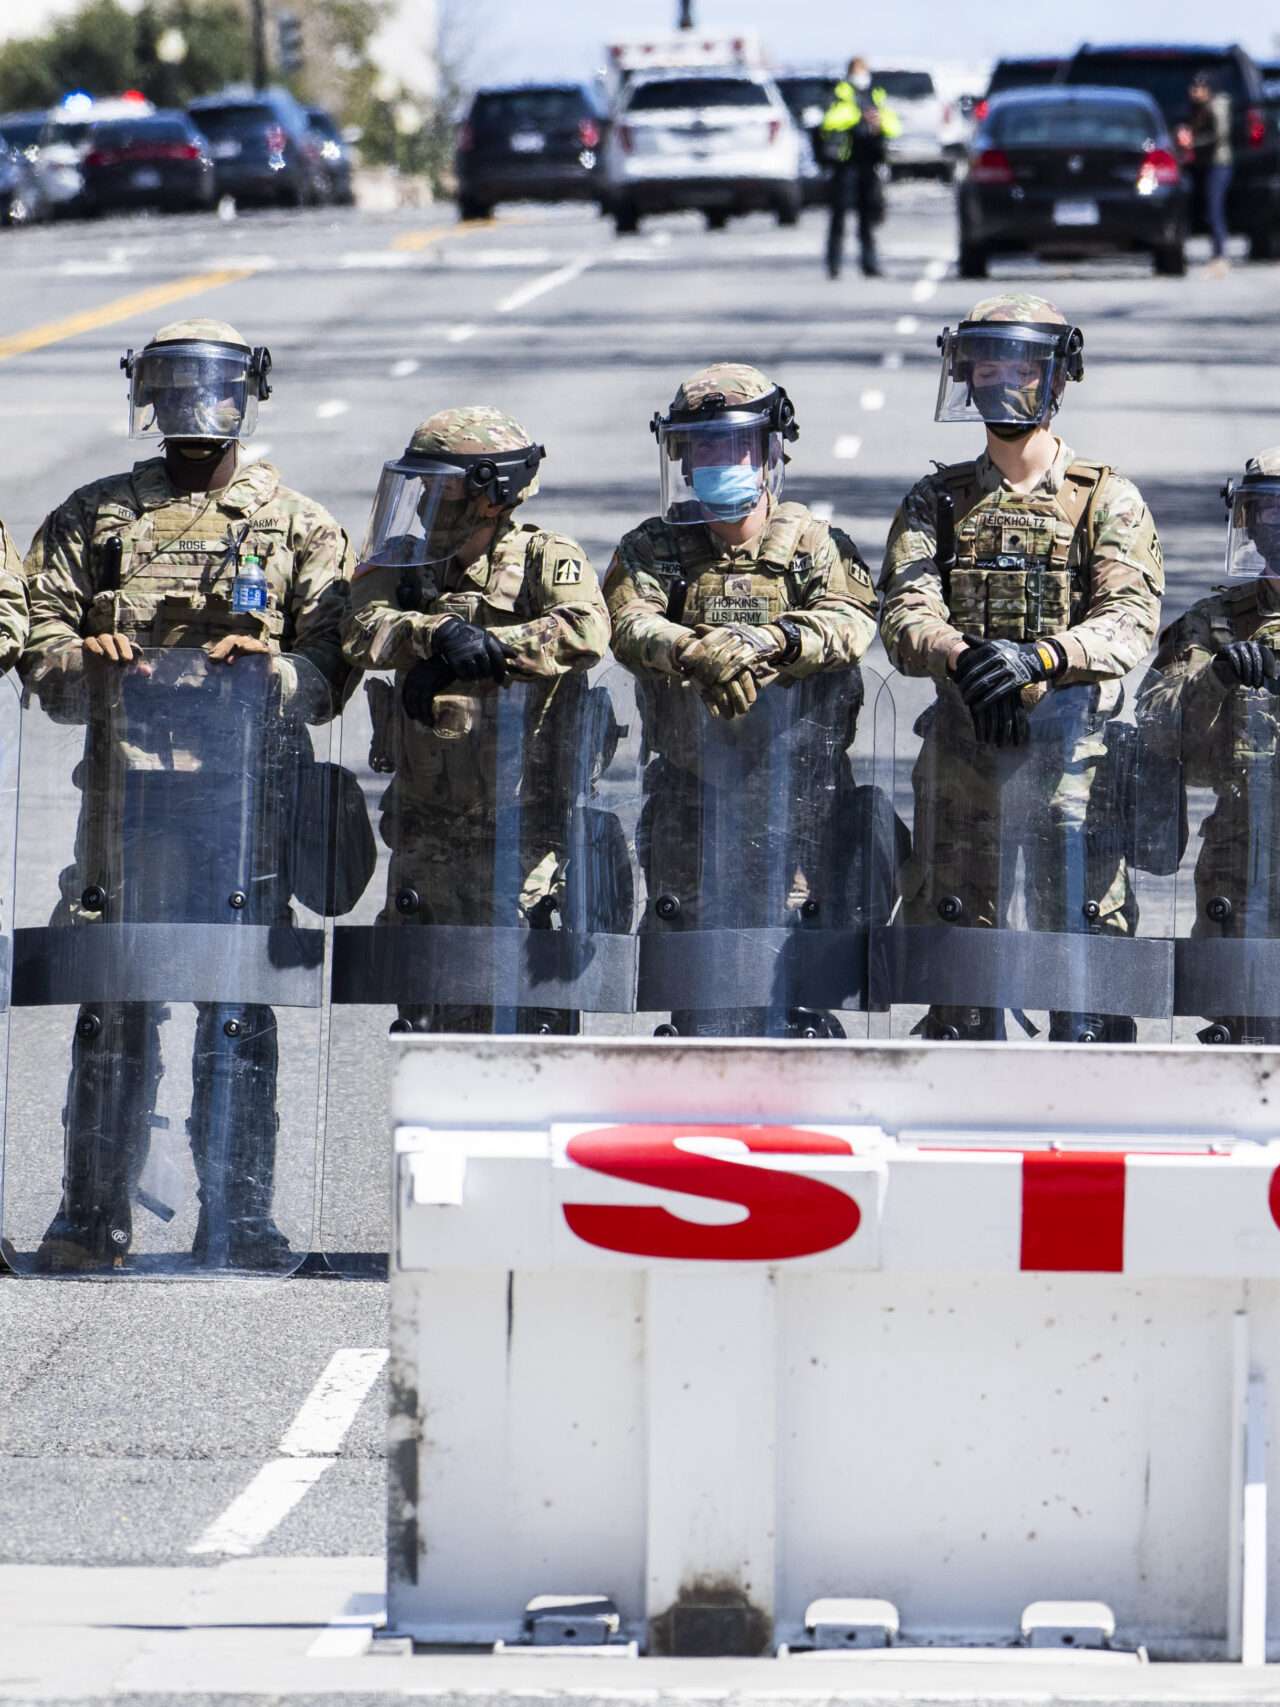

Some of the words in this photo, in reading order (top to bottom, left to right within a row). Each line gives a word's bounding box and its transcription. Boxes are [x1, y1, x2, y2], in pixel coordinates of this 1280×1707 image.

[253, 518, 279, 529] ARMY
[988, 514, 1046, 528] EICKHOLTZ
[179, 540, 207, 550] ROSE
[713, 598, 760, 609] HOPKINS
[734, 611, 762, 623] ARMY
